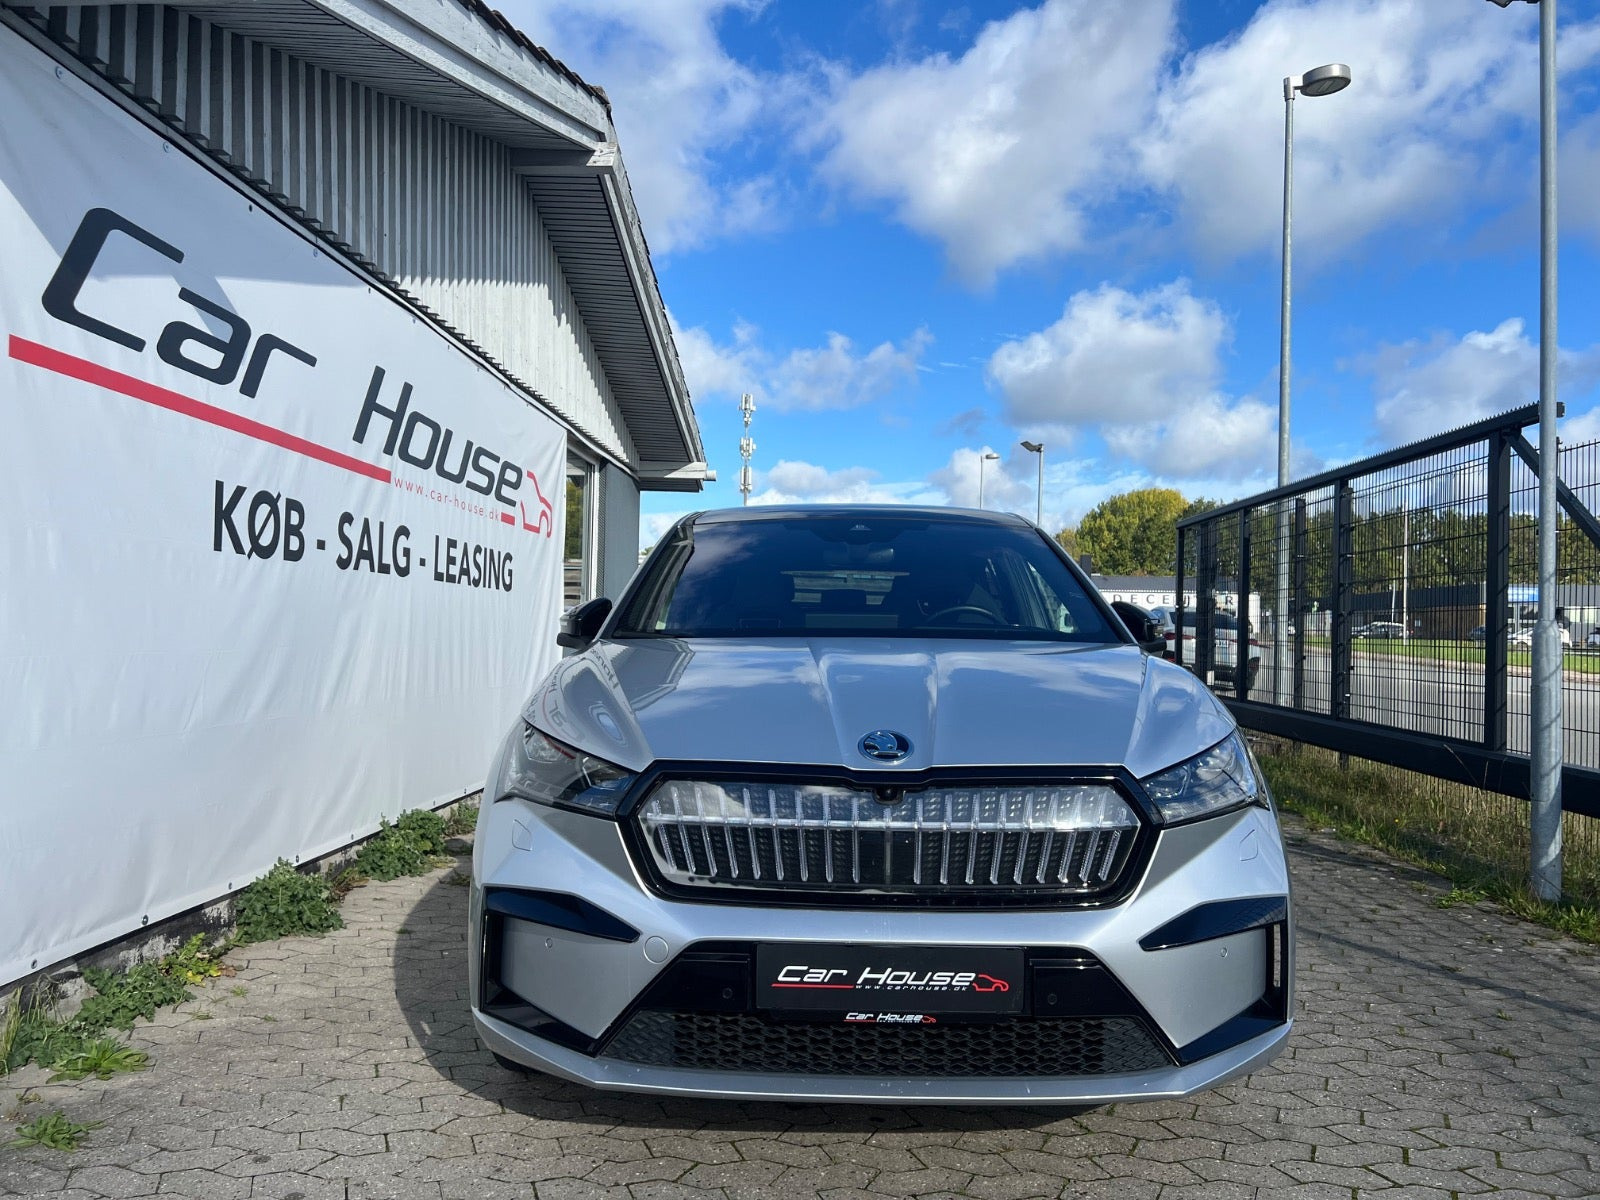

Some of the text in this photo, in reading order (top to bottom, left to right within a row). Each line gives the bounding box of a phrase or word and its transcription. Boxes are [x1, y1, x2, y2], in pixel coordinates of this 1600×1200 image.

[42, 207, 523, 507] Car House
[394, 476, 500, 521] www.car-house.dk
[213, 480, 305, 562] KØB
[336, 511, 411, 578] SALG
[433, 534, 513, 592] LEASING
[777, 965, 976, 986] Car House
[856, 984, 968, 992] www.carhouse.dk
[845, 1012, 923, 1021] Car House
